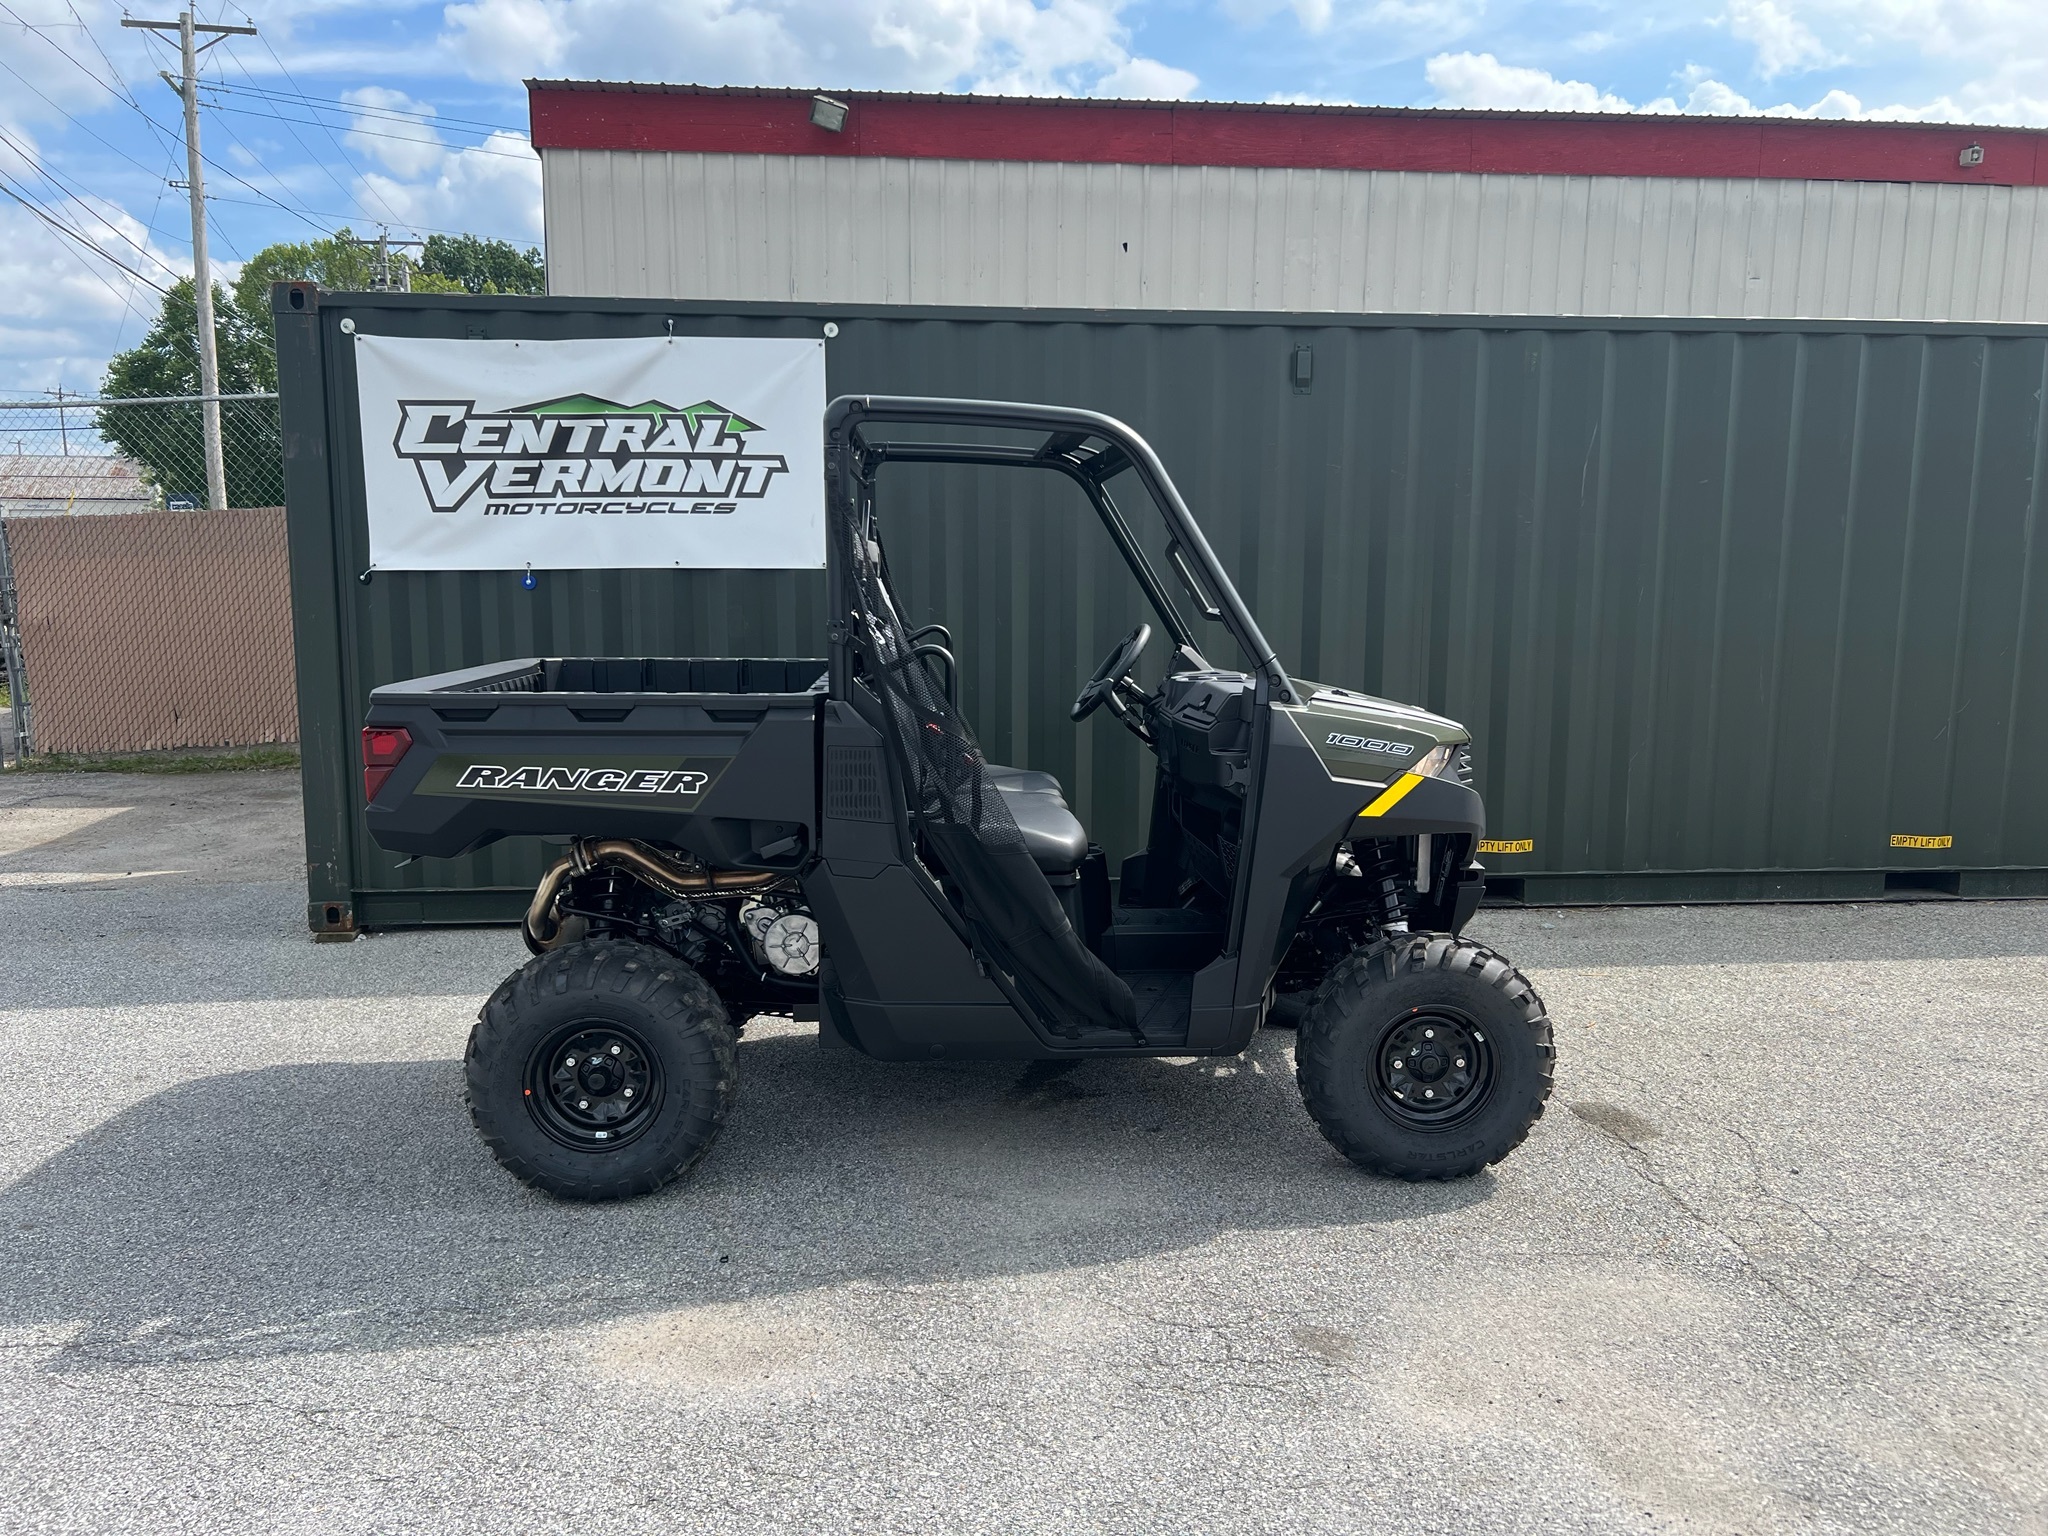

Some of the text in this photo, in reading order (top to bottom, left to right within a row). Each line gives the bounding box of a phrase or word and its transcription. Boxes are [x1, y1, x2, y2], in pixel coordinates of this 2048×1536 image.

[396, 401, 743, 456] CENTRAL
[418, 458, 787, 510] VERMONT
[483, 501, 738, 515] MOTORCYCLES
[1326, 732, 1414, 756] 1000
[456, 765, 709, 794] RANGER
[1477, 840, 1532, 852] PTY LIFT ONLY
[1891, 836, 1951, 847] EMPTY LIFT ONLY
[1407, 1139, 1486, 1160] CARLSTAR
